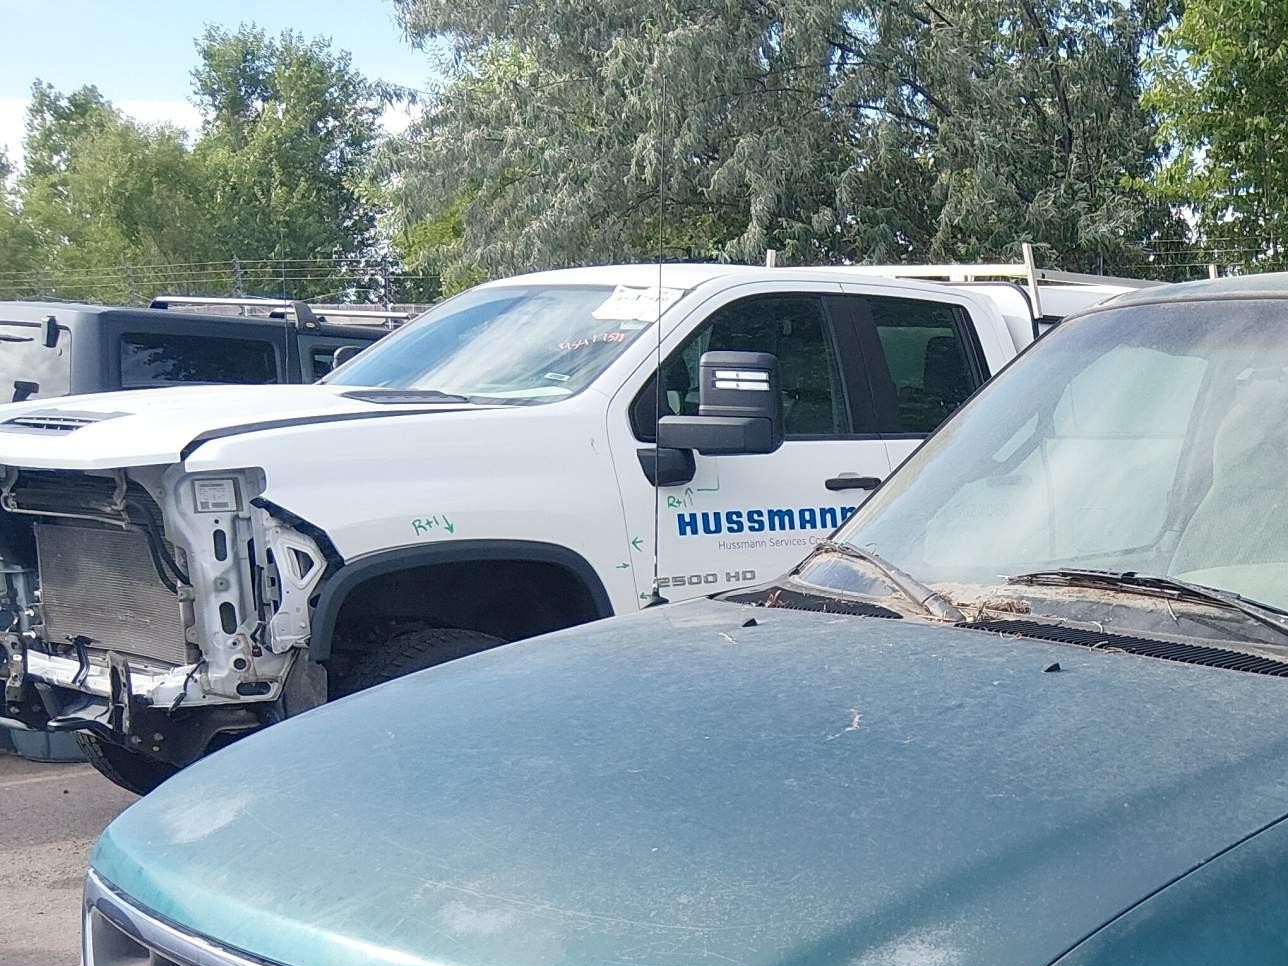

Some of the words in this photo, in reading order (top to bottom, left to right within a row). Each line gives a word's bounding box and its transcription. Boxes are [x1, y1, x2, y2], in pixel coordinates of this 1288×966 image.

[718, 539, 767, 551] Hussmann
[768, 537, 807, 547] Services
[654, 573, 718, 589] 2500
[725, 569, 756, 583] HD
